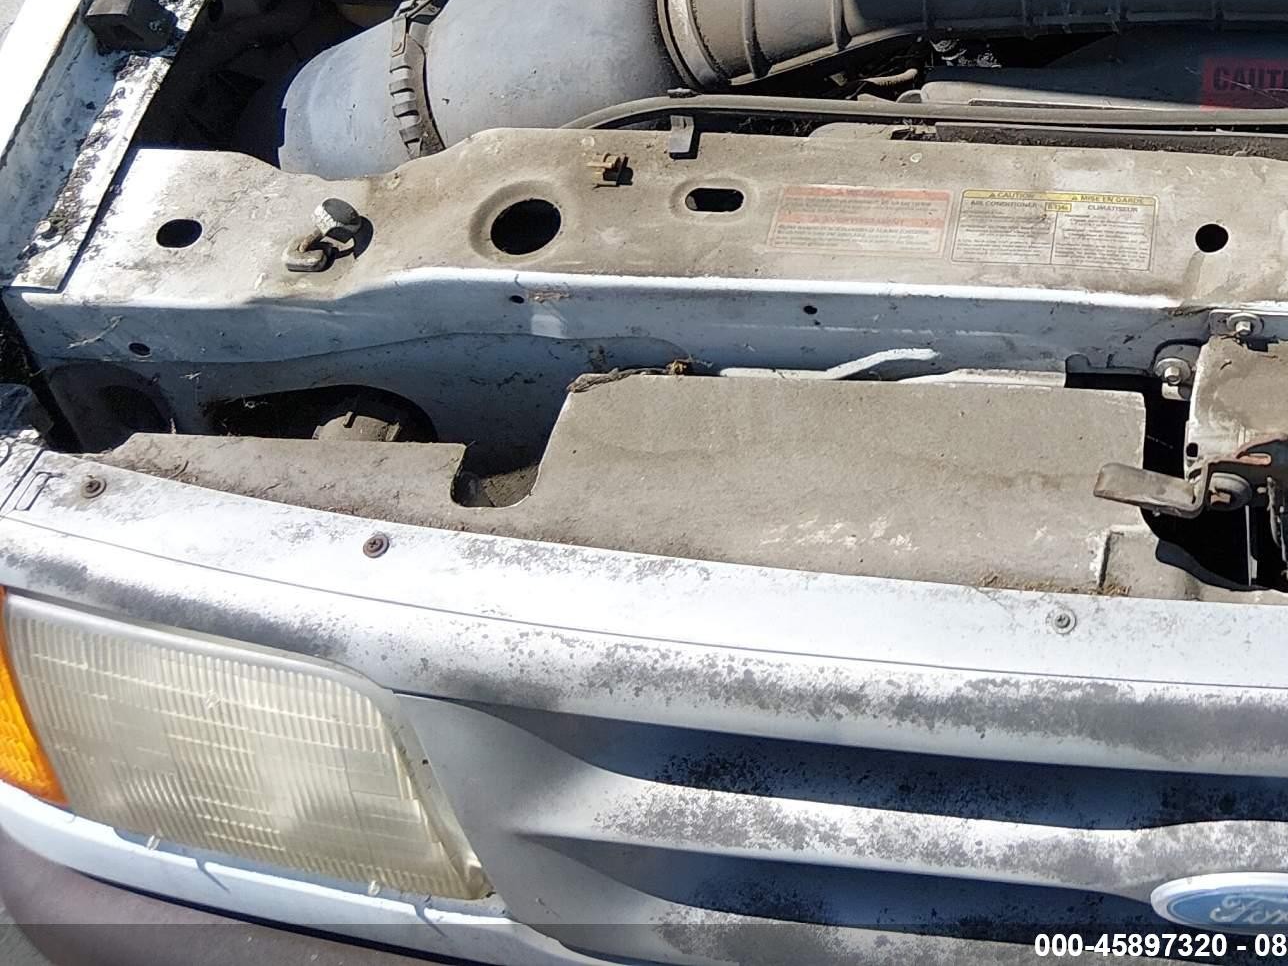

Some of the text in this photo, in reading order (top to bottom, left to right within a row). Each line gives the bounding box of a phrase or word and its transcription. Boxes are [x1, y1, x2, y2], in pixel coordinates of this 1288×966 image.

[997, 191, 1034, 199] CAUTION
[1080, 194, 1099, 202] MISE
[1102, 195, 1113, 203] EN
[1087, 204, 1139, 212] CLIMATISEUR
